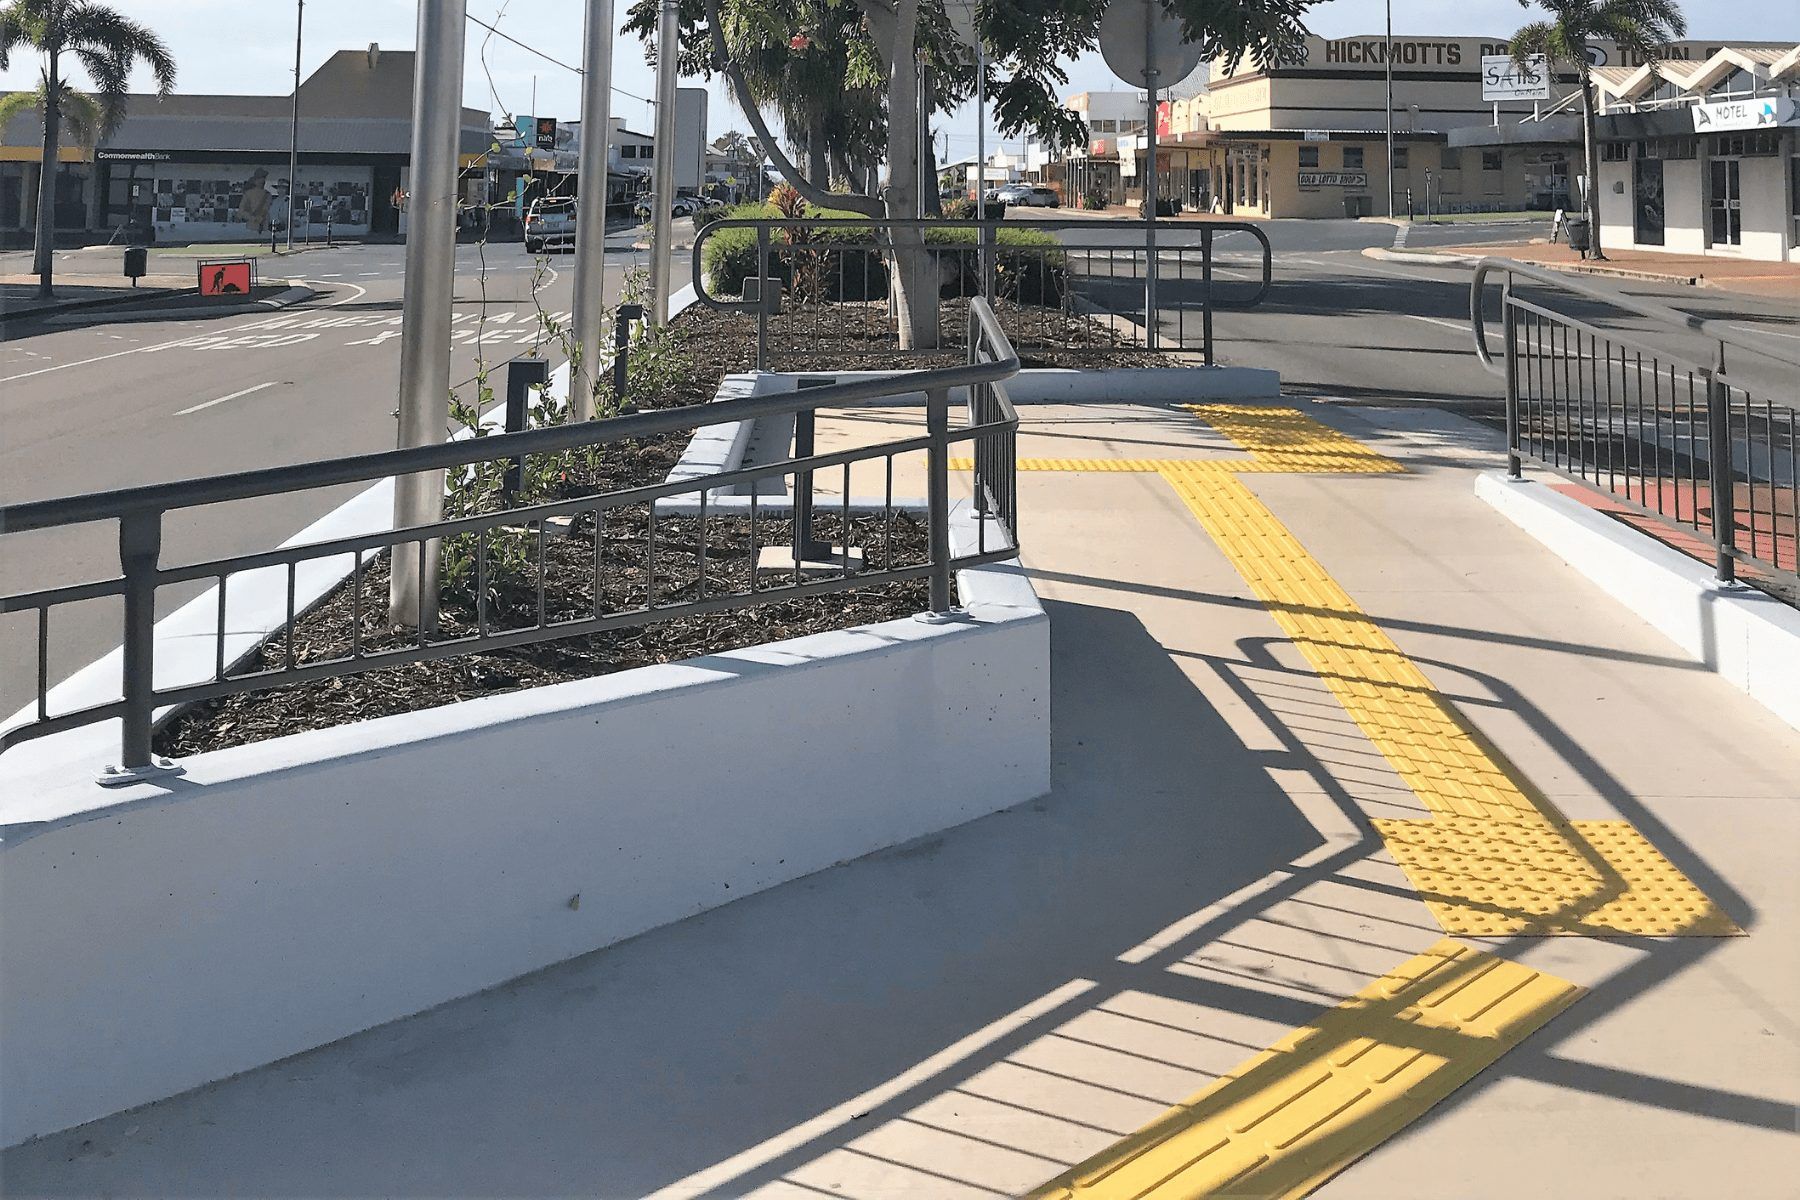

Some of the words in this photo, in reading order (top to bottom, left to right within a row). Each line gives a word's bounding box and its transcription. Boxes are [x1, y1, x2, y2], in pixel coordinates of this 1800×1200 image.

[1326, 41, 1461, 65] HICKMOTTS
[1716, 105, 1748, 120] MOTEL
[141, 333, 320, 352] PED
